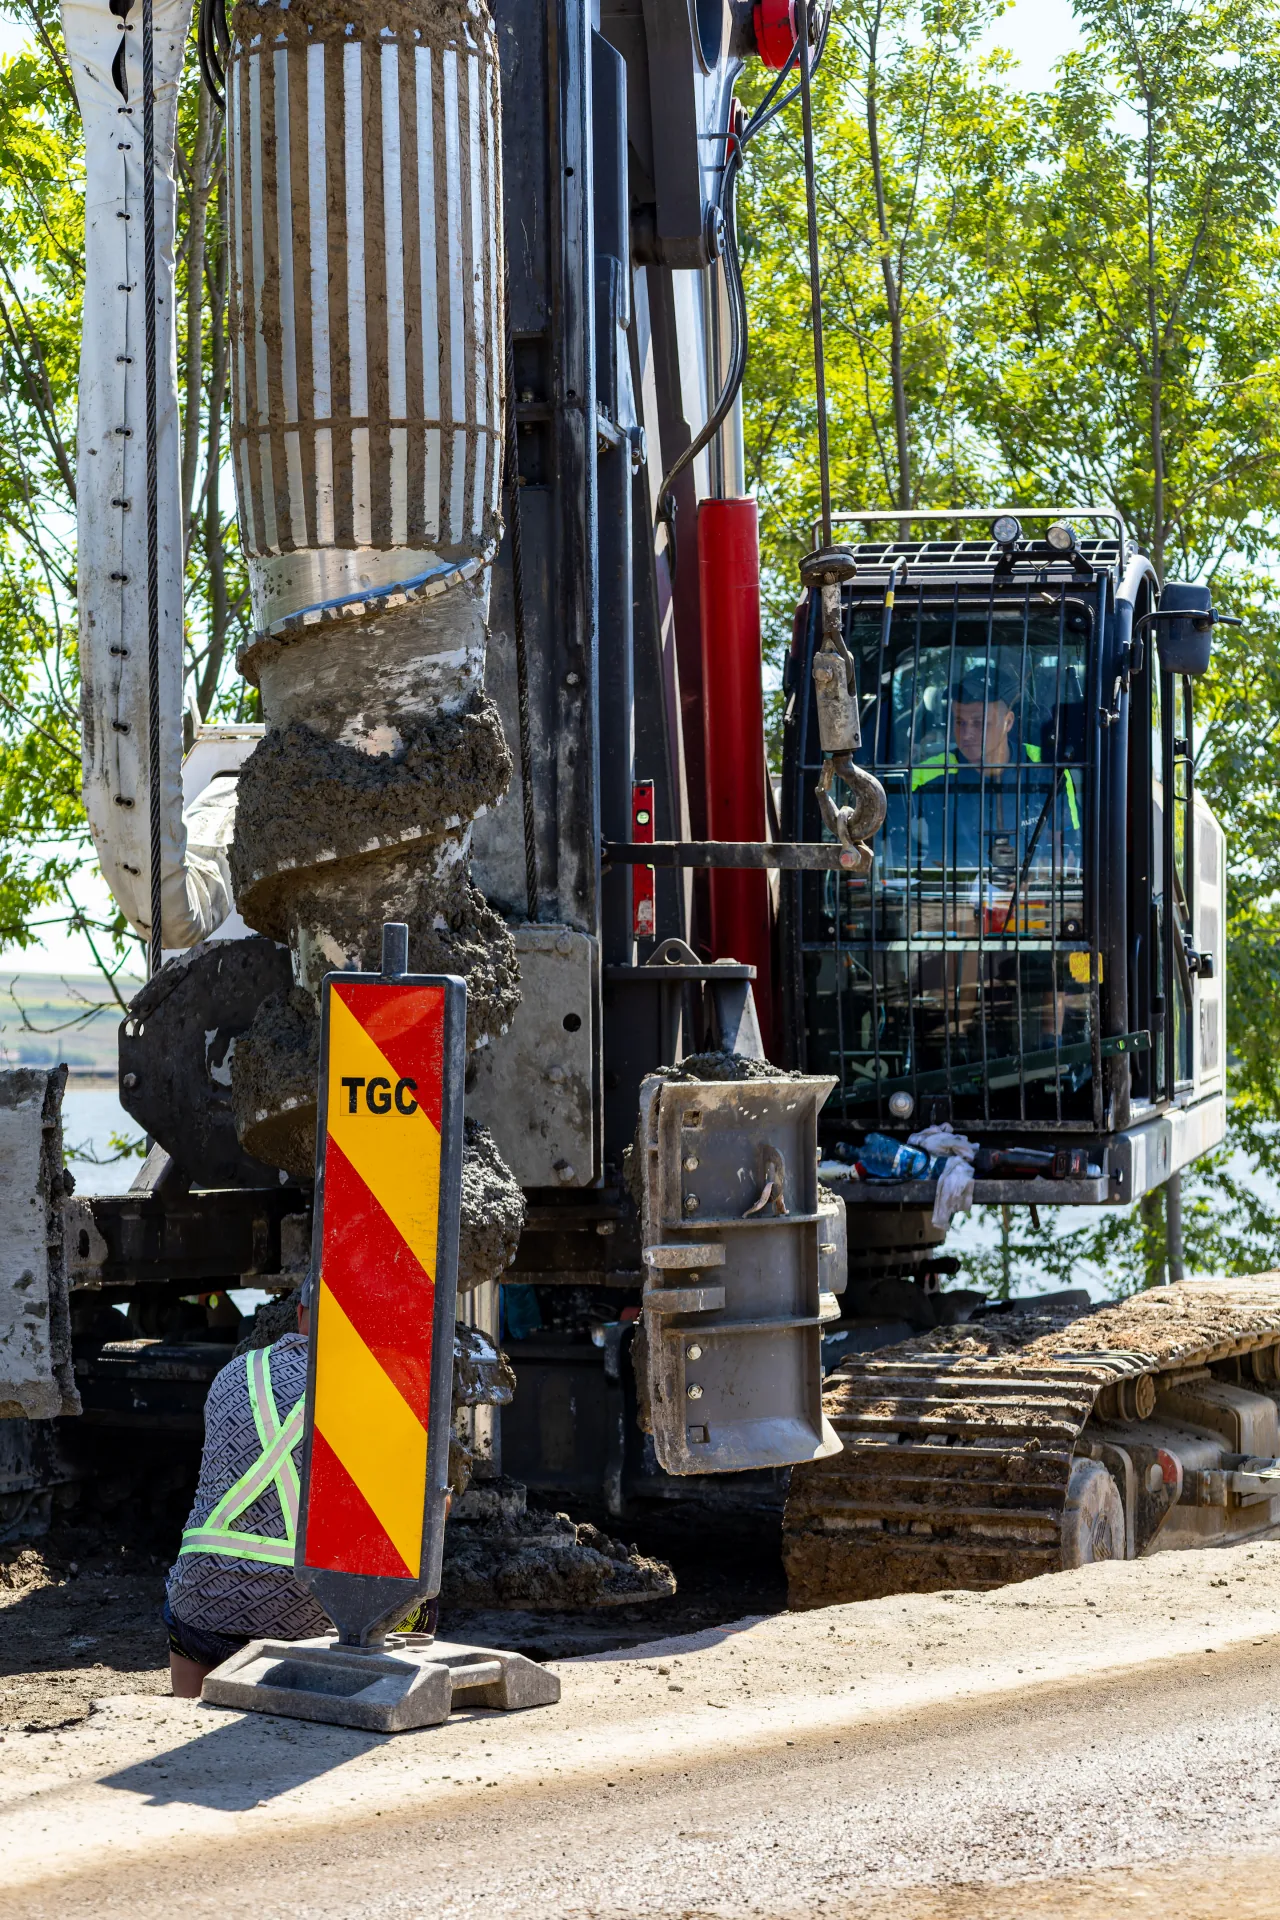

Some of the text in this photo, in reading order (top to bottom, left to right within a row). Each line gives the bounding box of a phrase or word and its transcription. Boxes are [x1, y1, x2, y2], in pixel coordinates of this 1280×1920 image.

[341, 1077, 418, 1115] TGC
[182, 1556, 222, 1589] MARVEL
[203, 1564, 253, 1599] MARVEL
[202, 1588, 254, 1625] MARVEL
[248, 1587, 302, 1625] MARVEL
